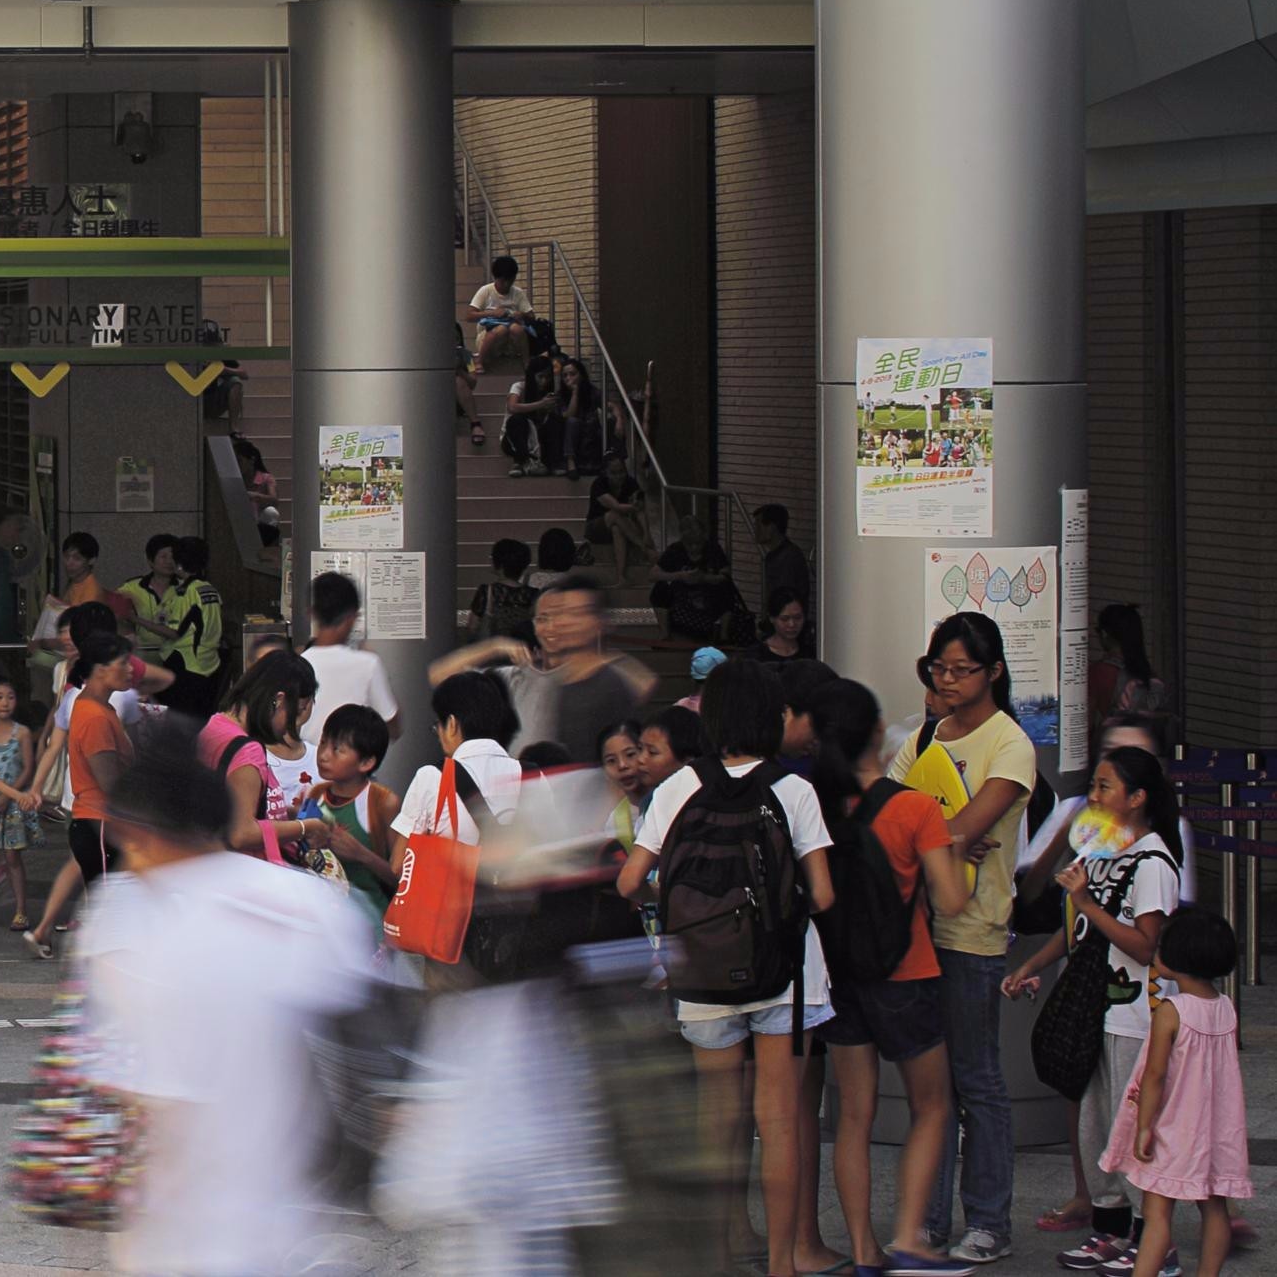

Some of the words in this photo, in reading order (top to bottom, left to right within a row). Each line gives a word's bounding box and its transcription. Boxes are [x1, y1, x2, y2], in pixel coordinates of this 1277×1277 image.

[126, 304, 196, 327] RATE
[143, 328, 231, 345] STUDENT
[874, 347, 921, 375] 全民
[891, 362, 963, 394] 運動日
[330, 431, 360, 449] 全民
[341, 440, 385, 459] 運動日
